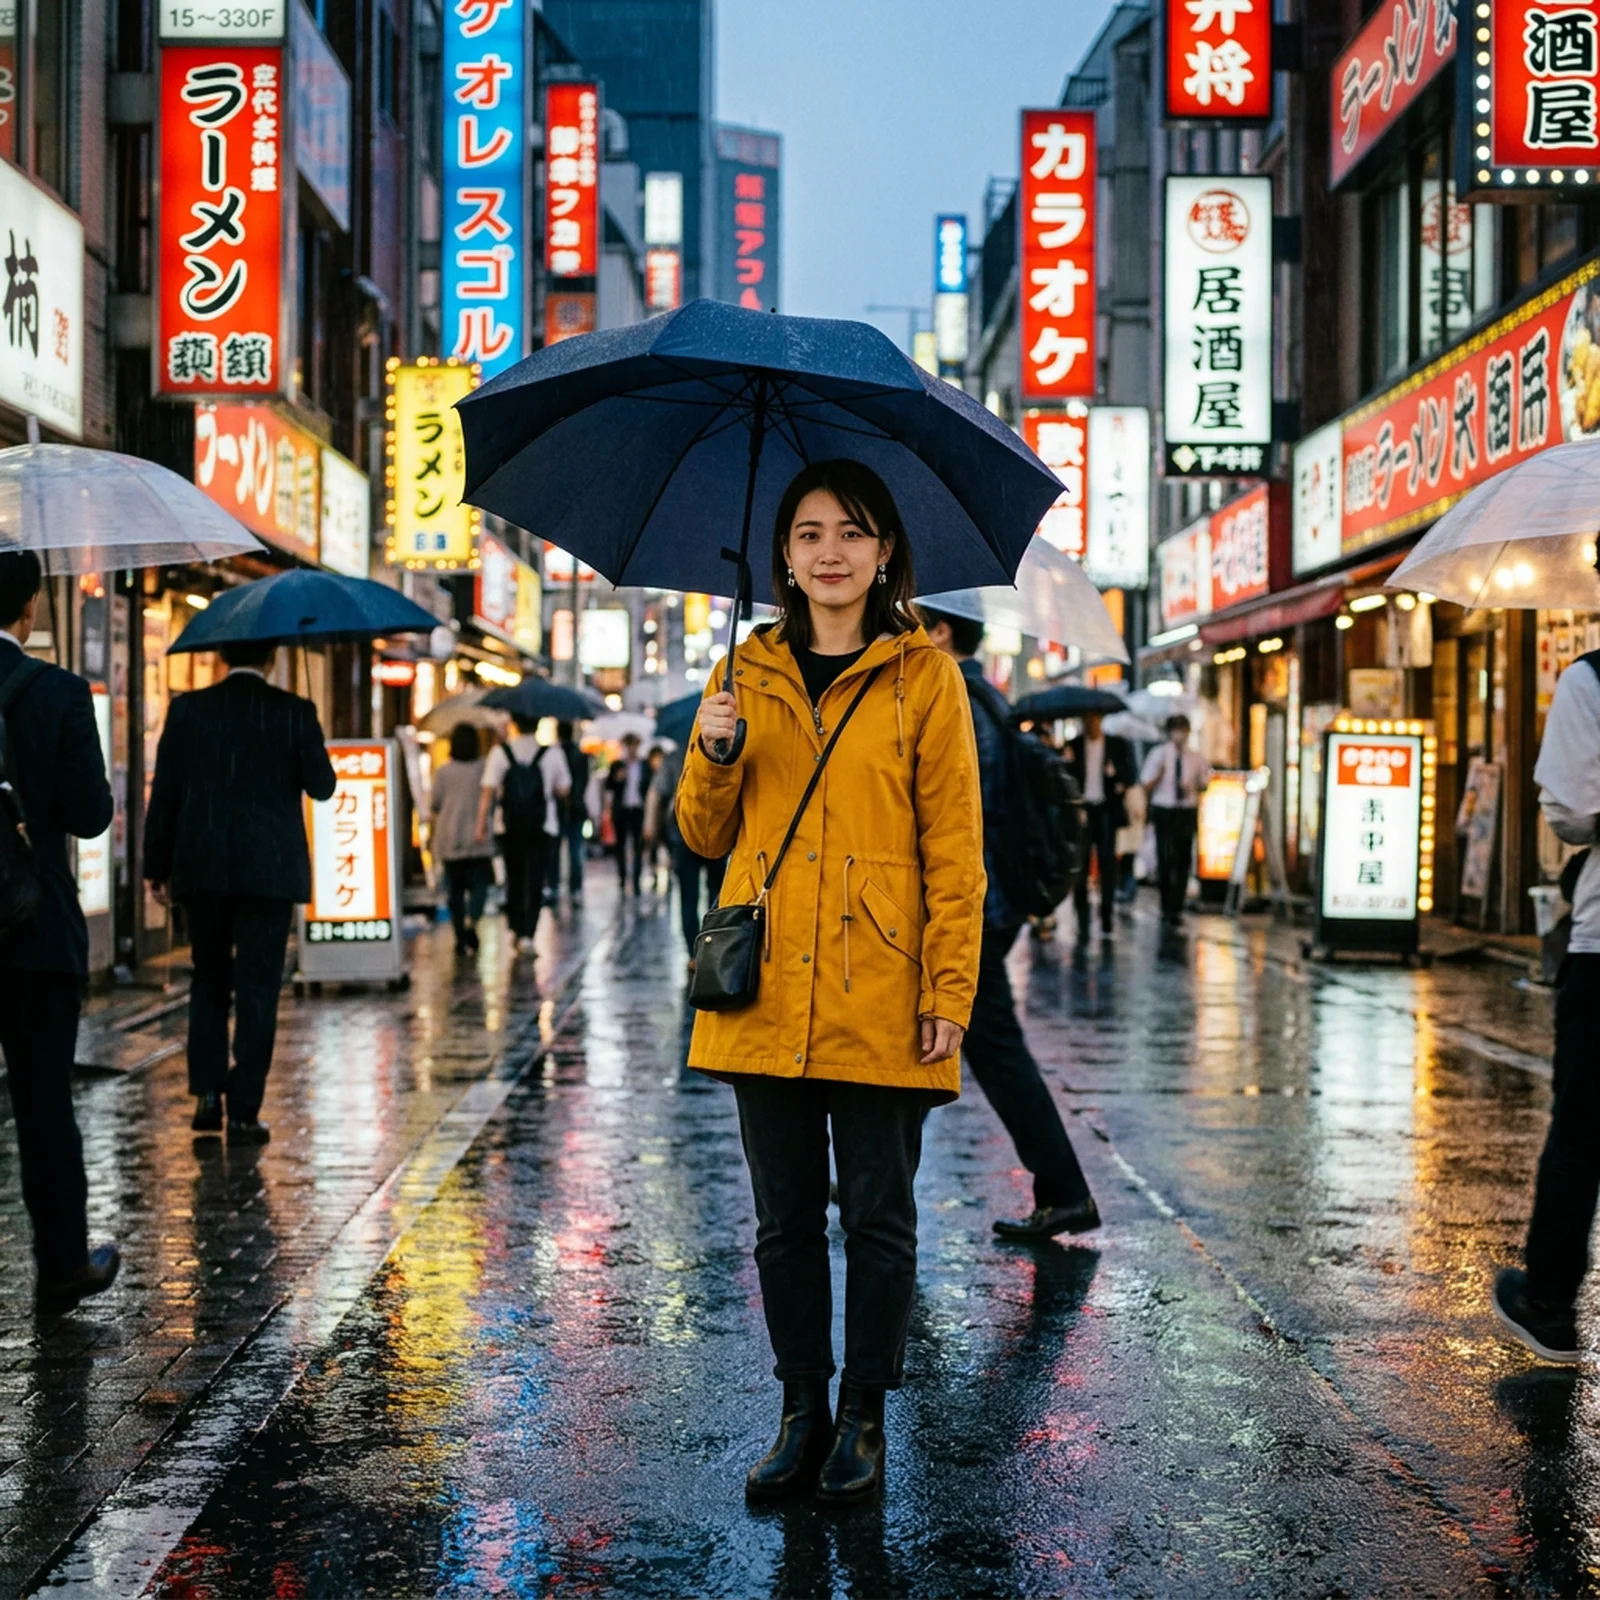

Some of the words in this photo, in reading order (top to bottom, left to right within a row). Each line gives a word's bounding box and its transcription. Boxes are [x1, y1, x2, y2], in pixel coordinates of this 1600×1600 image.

[1523, 0, 1598, 149] 酒屋
[180, 62, 248, 321] ラーメン
[455, 0, 513, 362] ケオレスゴル
[1029, 123, 1088, 386] カラオケ
[1192, 266, 1244, 430] 居酒屋
[415, 412, 444, 519] ラメン
[334, 790, 361, 908] カラオケ
